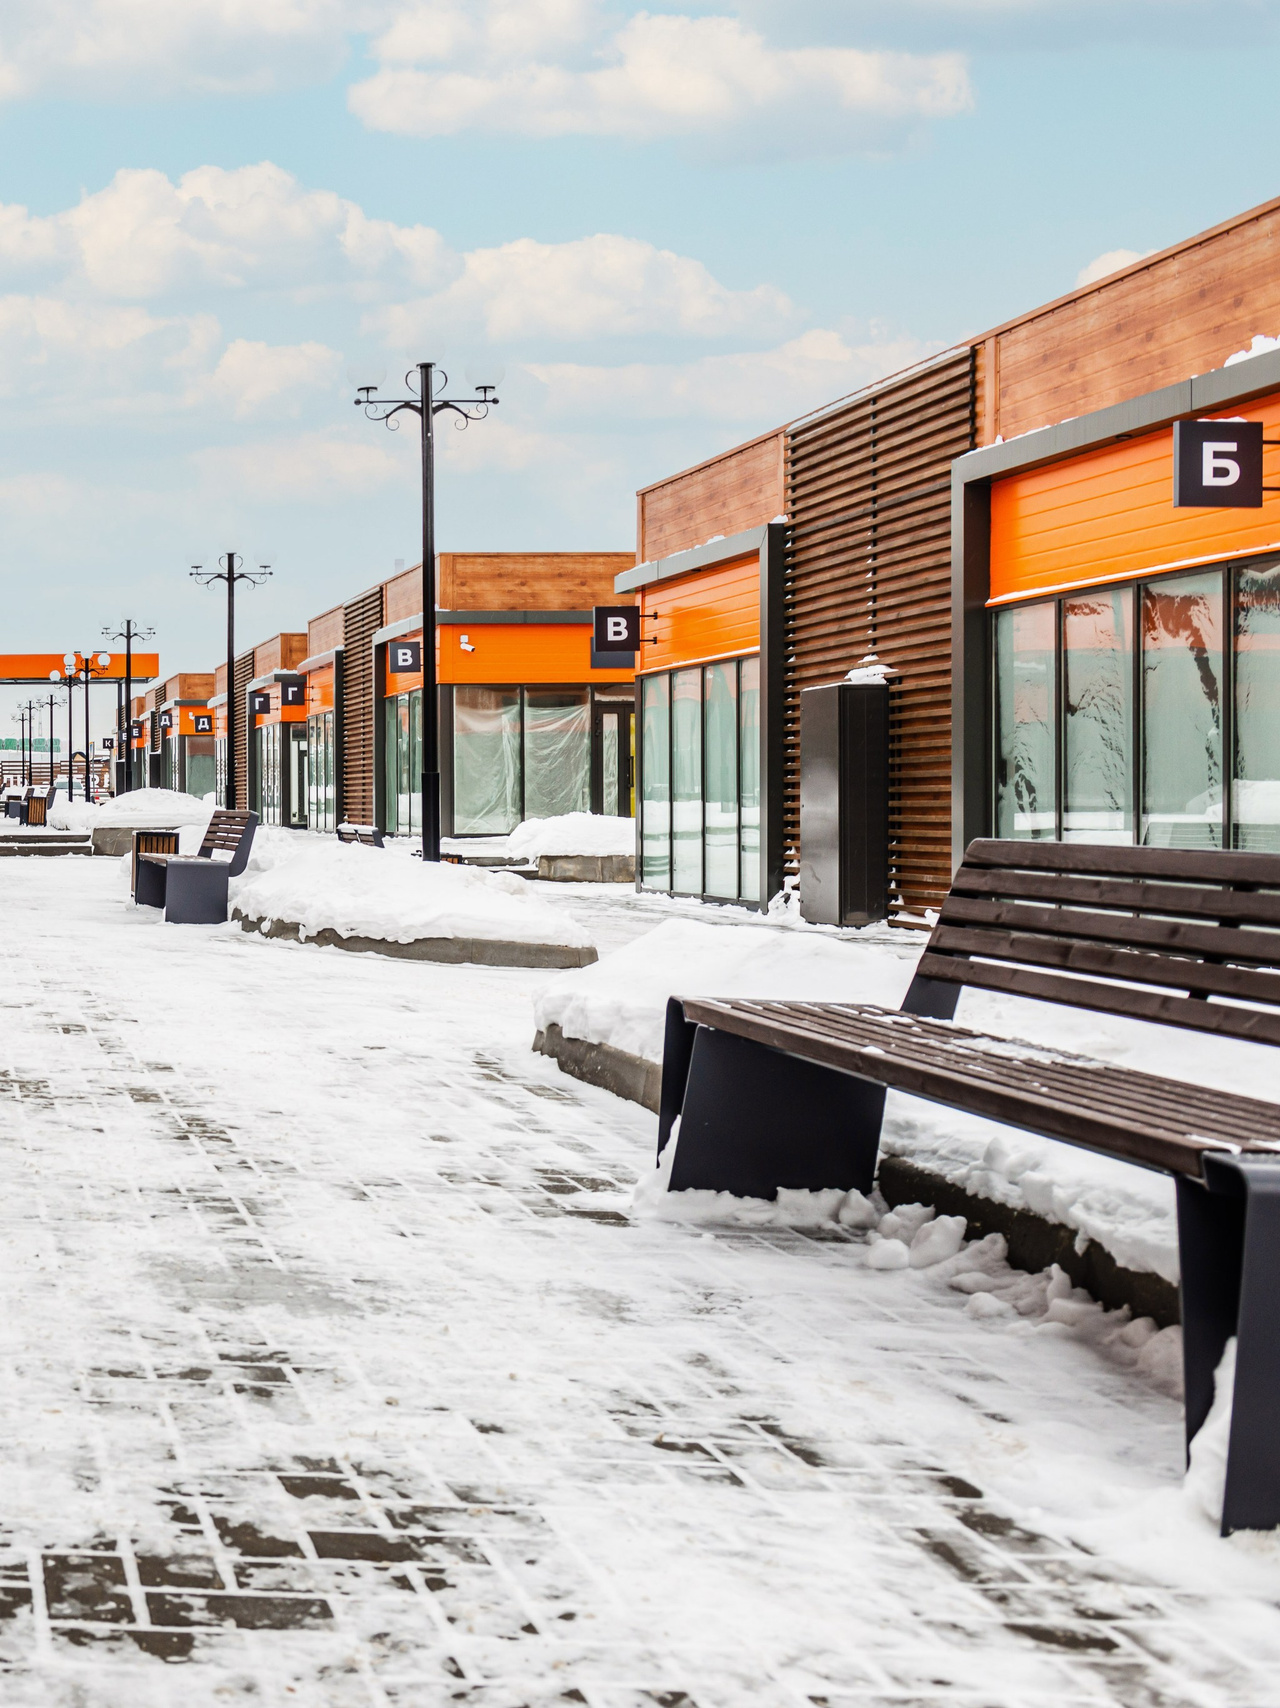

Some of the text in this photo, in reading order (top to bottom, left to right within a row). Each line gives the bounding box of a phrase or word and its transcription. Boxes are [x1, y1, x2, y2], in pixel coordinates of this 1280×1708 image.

[1203, 441, 1241, 487] Б
[607, 616, 629, 641] В
[397, 648, 413, 666] В
[287, 687, 298, 701] Г
[255, 697, 264, 710] Г
[160, 715, 170, 727] Д
[198, 717, 210, 731] Д
[133, 728, 139, 736] Е
